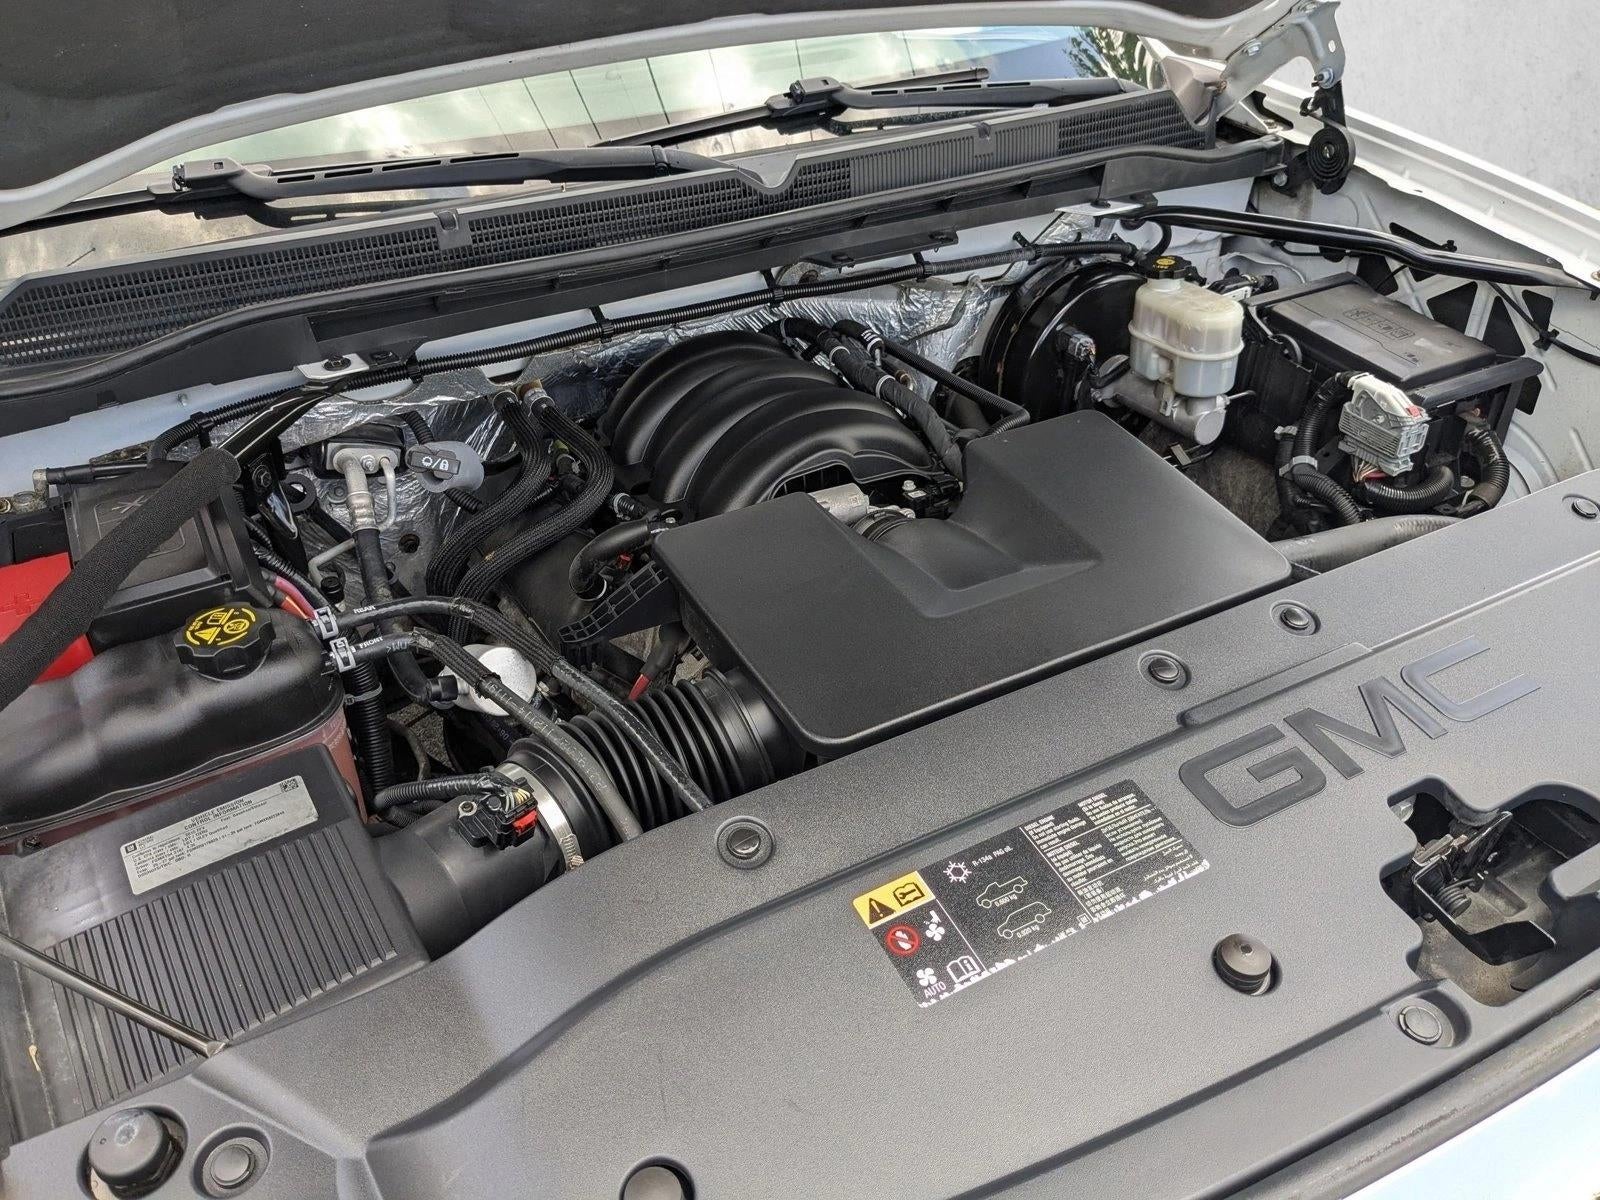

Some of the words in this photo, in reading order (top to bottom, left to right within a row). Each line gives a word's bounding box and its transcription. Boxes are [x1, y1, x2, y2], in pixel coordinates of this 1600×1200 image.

[360, 635, 383, 649] FRONT
[1178, 634, 1542, 828] GMC
[184, 816, 211, 830] CONTROL
[213, 800, 252, 818] INFORMATION
[971, 854, 993, 867] R-134a
[1008, 894, 1018, 902] kg
[1029, 925, 1040, 935] kg
[923, 981, 947, 999] AUTO
